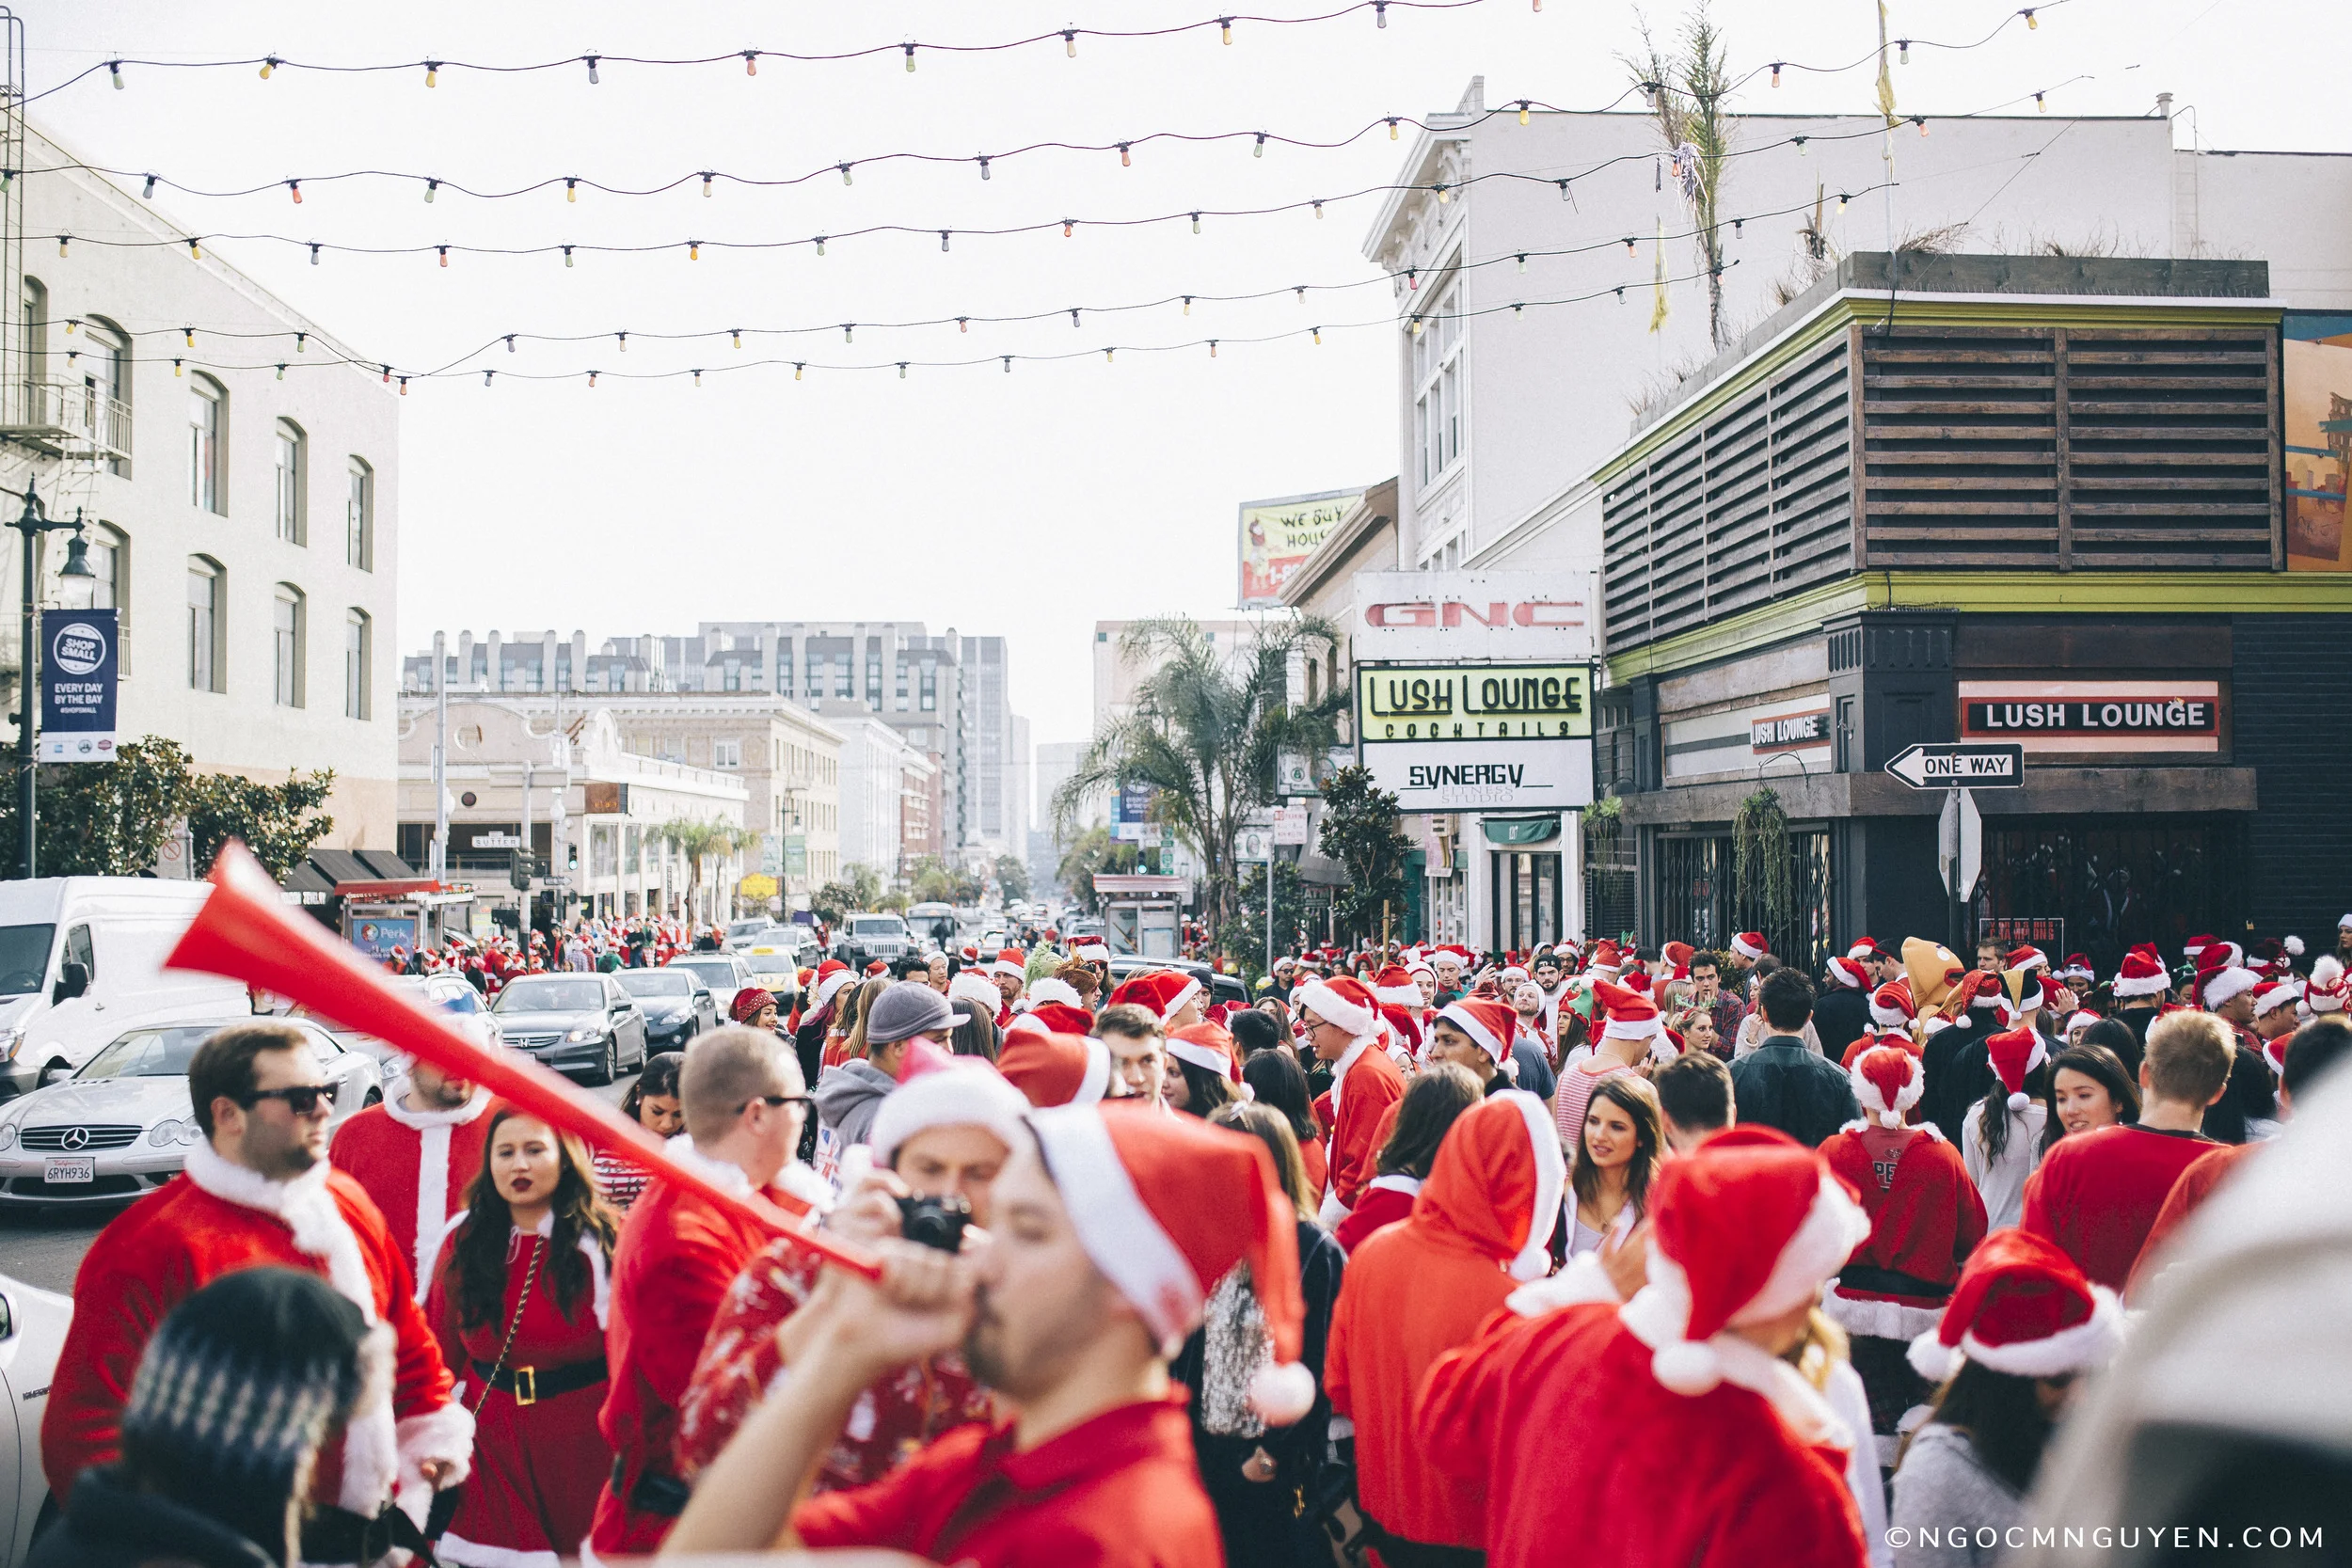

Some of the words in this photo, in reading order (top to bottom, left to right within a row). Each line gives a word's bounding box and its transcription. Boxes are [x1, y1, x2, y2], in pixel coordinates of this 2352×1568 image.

[1280, 513, 1306, 528] WE
[1313, 506, 1343, 526] BUY
[1365, 601, 1584, 628] GNC
[65, 638, 96, 651] SHOP
[61, 646, 96, 660] SMALL
[55, 683, 84, 693] EVERY
[85, 683, 103, 693] DAY
[55, 694, 67, 705] BY
[67, 694, 84, 705] THE
[85, 694, 103, 705] BAY
[1370, 676, 1453, 717] LUSH
[1463, 674, 1582, 715] LOUNGE
[1986, 704, 2066, 728] LUSH
[2082, 702, 2205, 727] LOUNGE
[1386, 721, 1569, 738] COCKTAILS
[1750, 722, 1776, 746] LUSH
[1776, 714, 1820, 742] LOUNGE
[1924, 755, 1963, 775] ONE
[1970, 757, 2008, 775] WAY
[1441, 785, 1515, 796] FITNESS
[1441, 793, 1515, 805] STUDIO
[380, 927, 405, 939] Perk
[47, 1166, 90, 1180] 6RYH936
